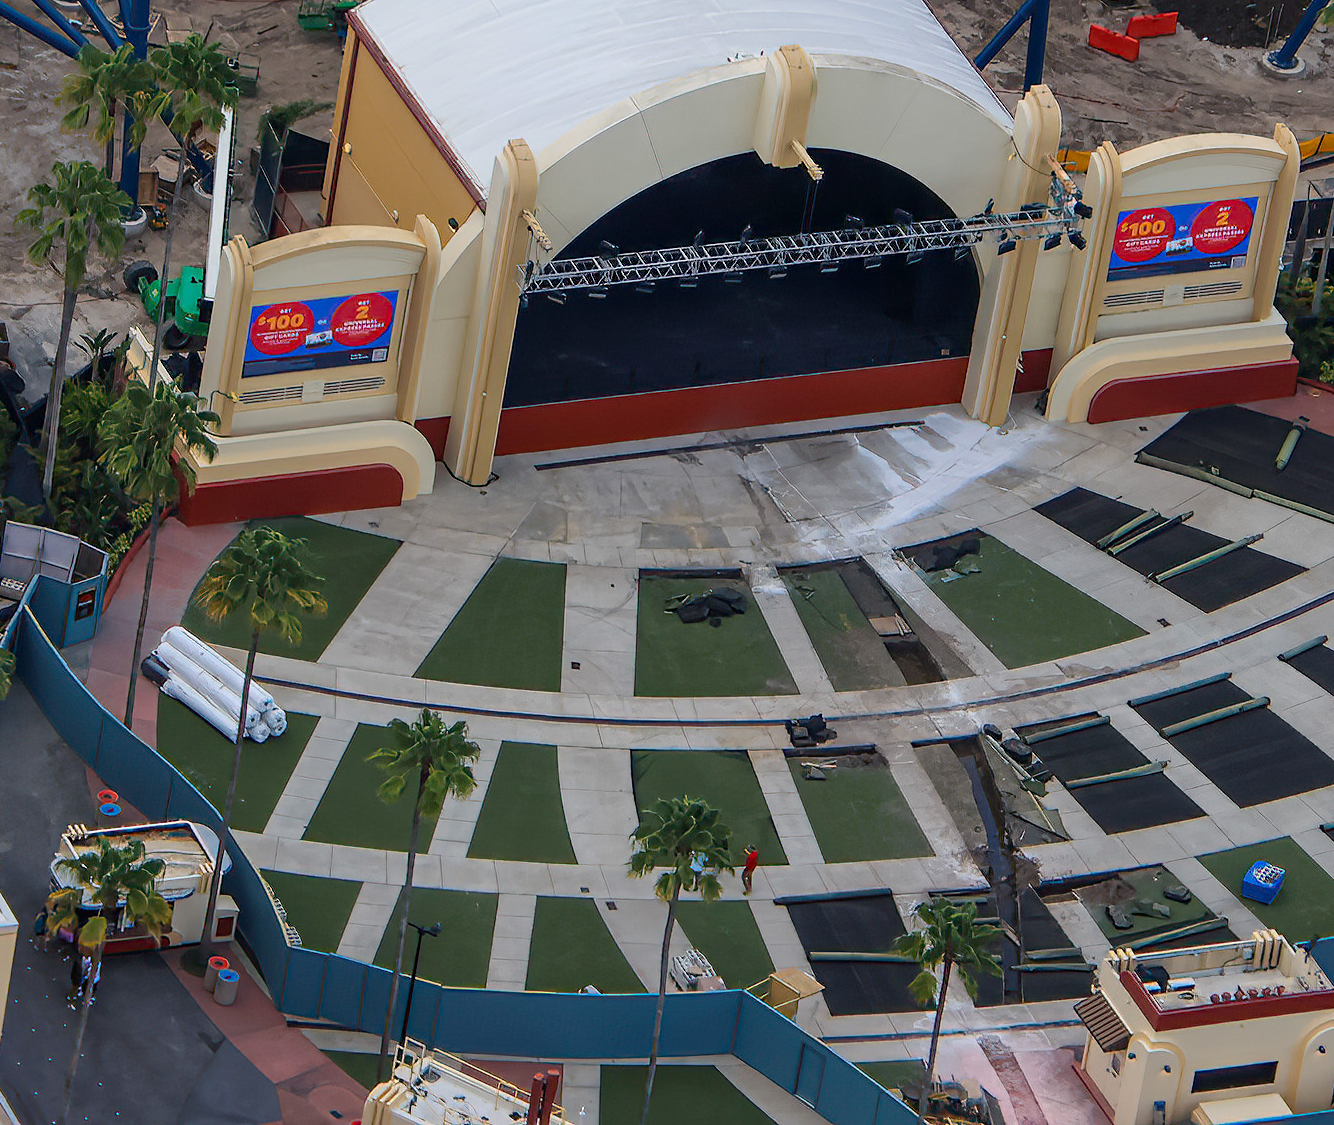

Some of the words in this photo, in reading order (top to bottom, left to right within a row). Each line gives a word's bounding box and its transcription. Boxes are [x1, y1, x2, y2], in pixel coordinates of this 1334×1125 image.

[1216, 211, 1230, 227] 2
[1121, 220, 1166, 237] $100
[355, 305, 370, 320] 2
[258, 313, 305, 330] $100
